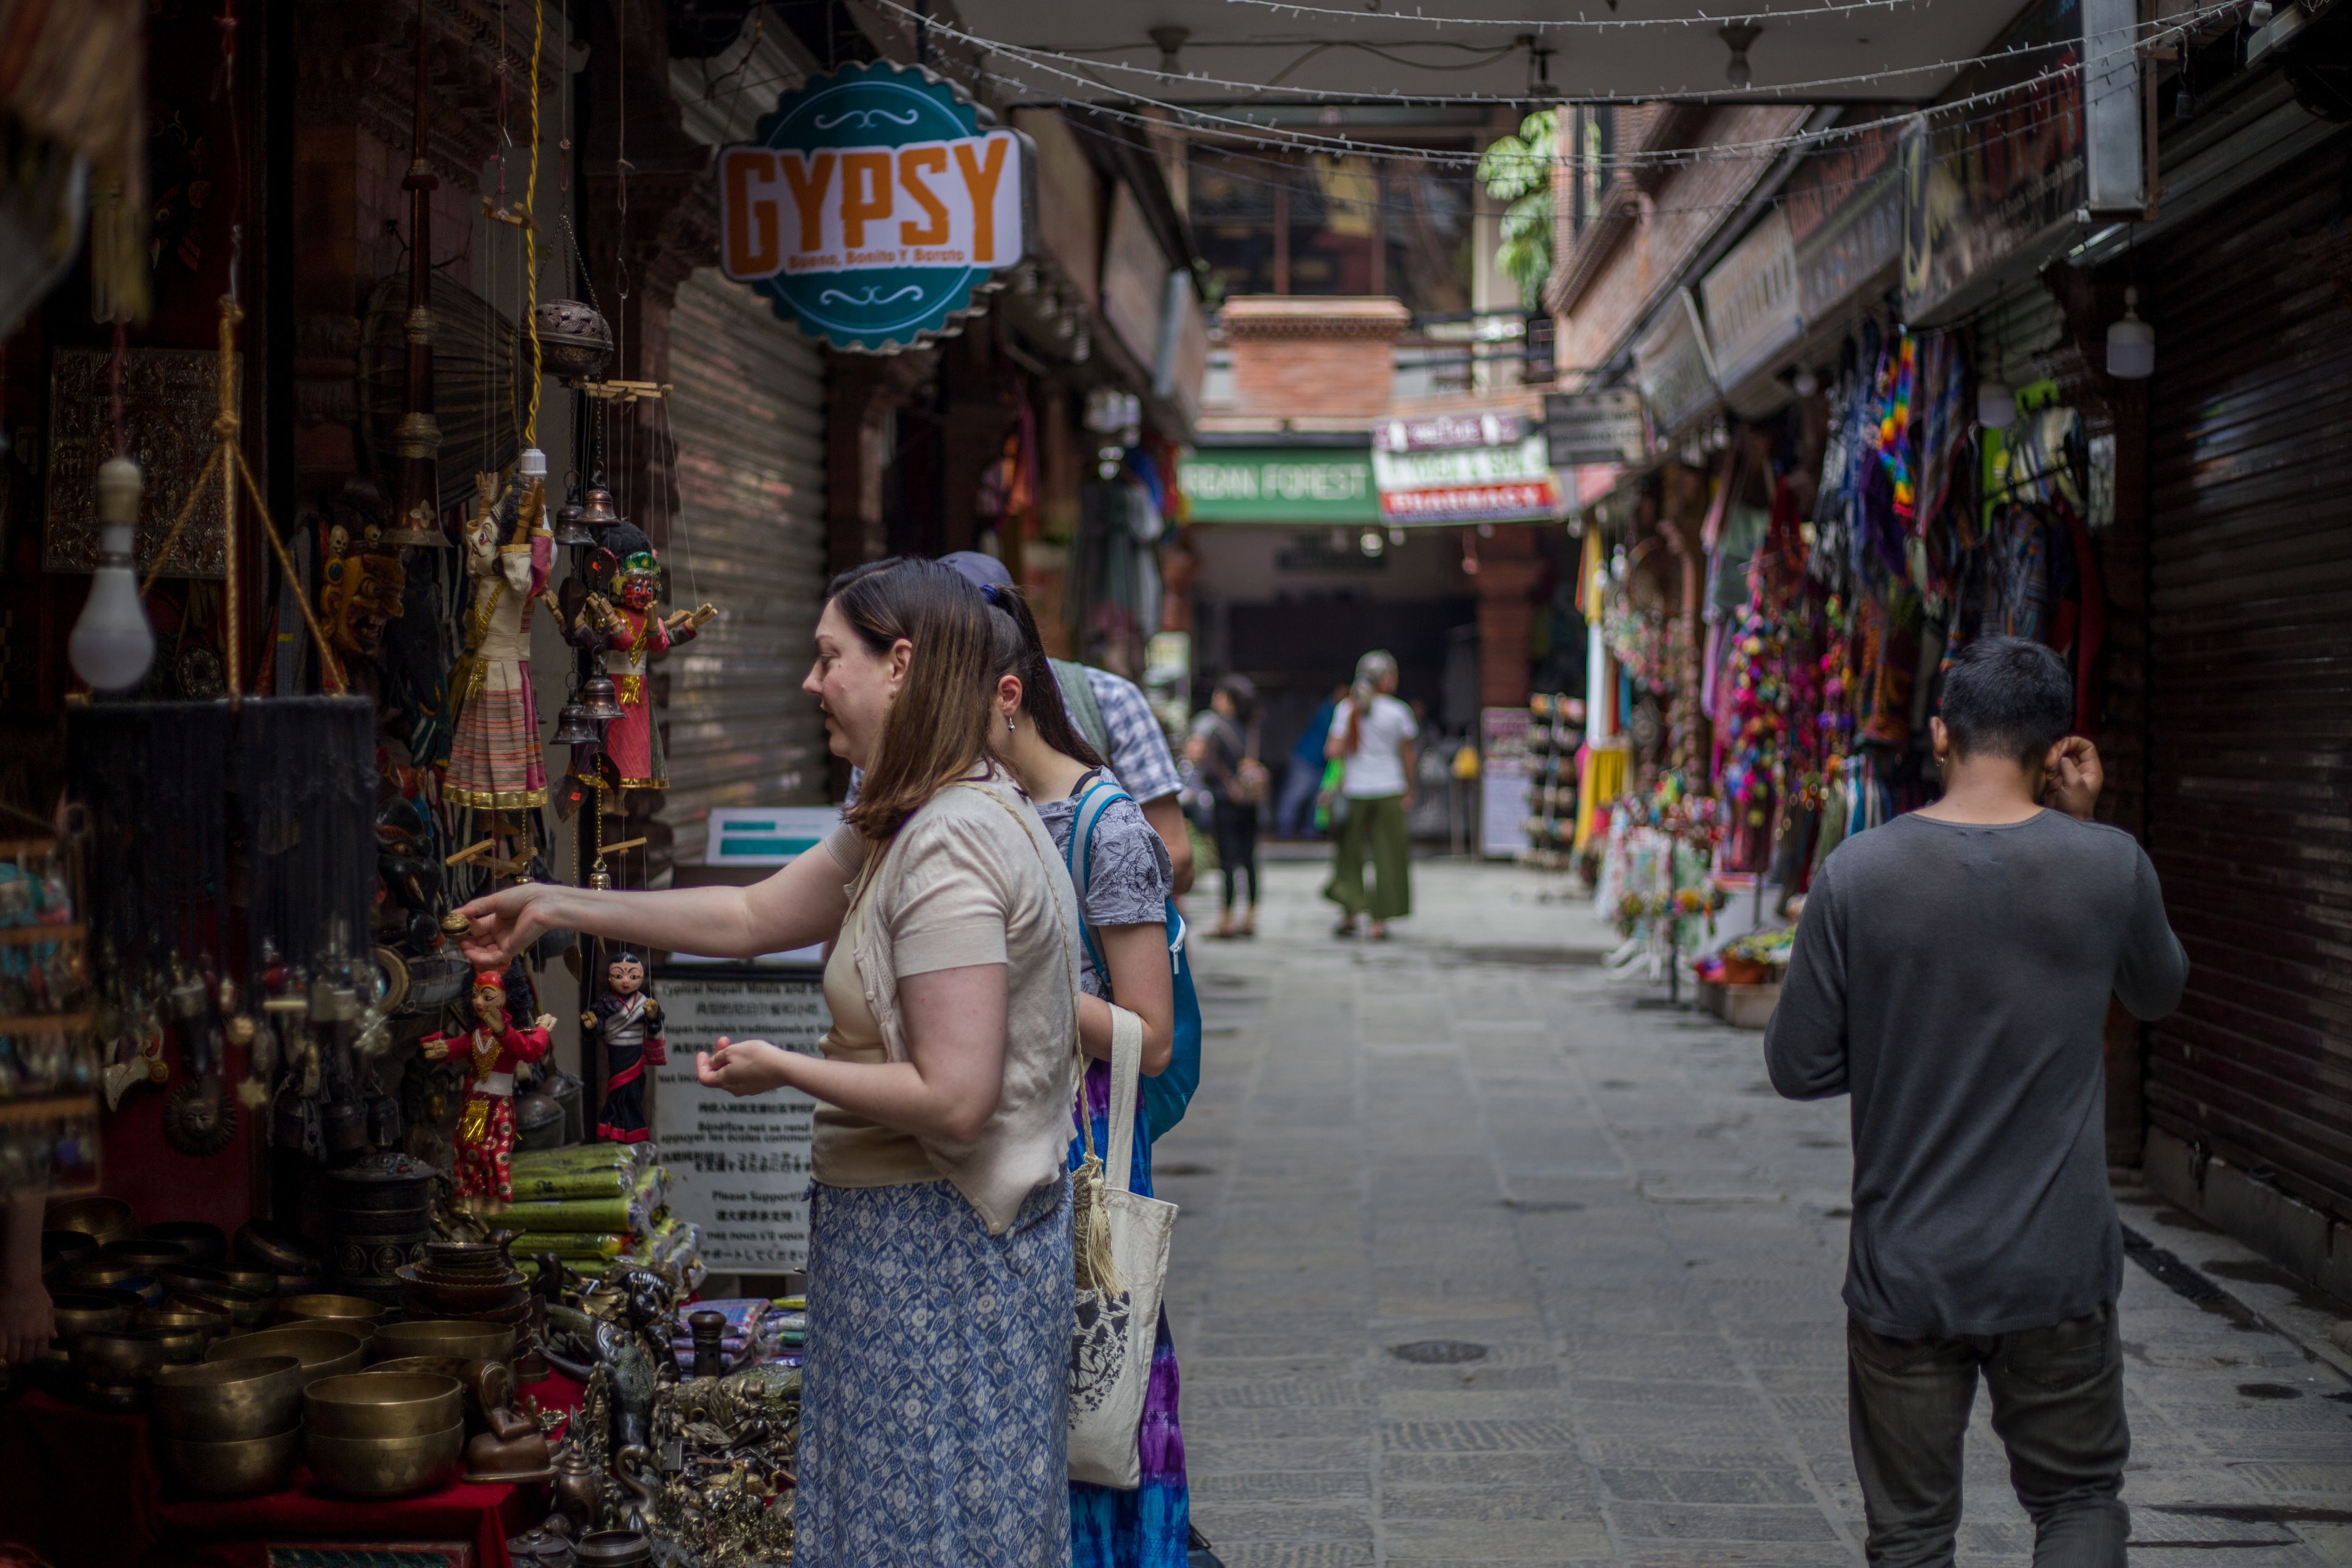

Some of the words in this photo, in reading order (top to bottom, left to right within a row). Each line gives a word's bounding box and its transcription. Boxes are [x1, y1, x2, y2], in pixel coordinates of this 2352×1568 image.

[726, 138, 1009, 276] GYPSY
[846, 251, 895, 265] Bonito
[899, 249, 908, 262] Y
[913, 248, 965, 262] Barato
[1177, 464, 1259, 500] RBAN
[1261, 464, 1370, 500] FOREST
[712, 1191, 745, 1200] Please
